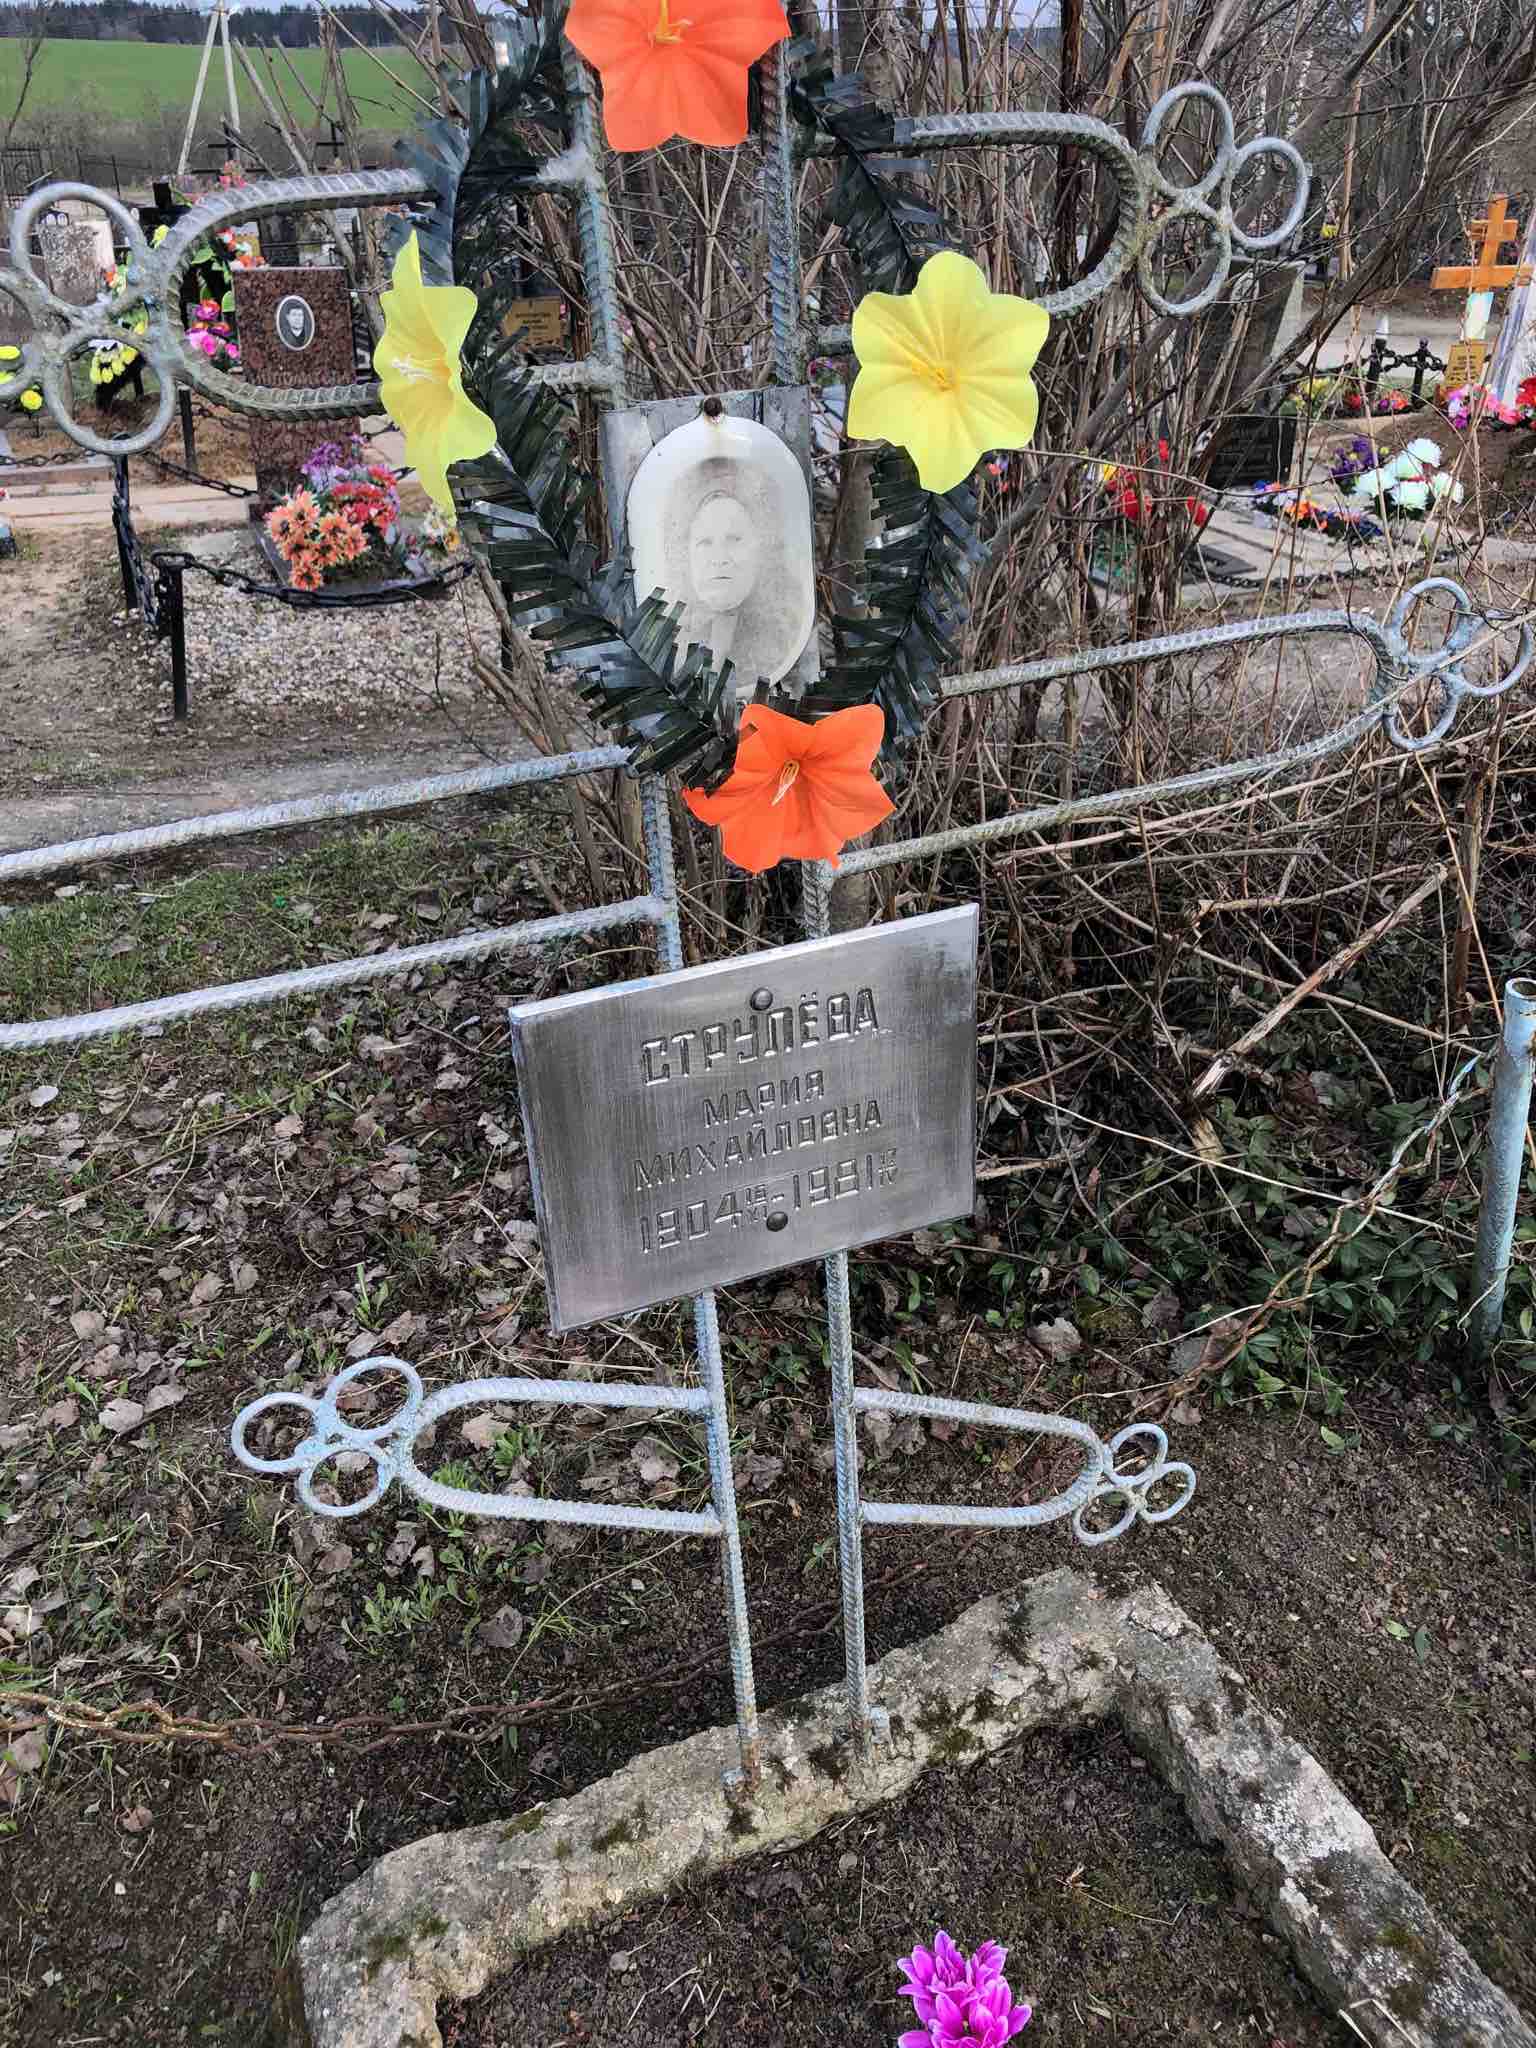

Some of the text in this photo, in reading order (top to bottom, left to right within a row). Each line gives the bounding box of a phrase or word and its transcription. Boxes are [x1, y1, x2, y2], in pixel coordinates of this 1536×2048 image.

[641, 988, 879, 1086] СТРУЛЁВА
[703, 1070, 825, 1128] МАРИЯ
[632, 1100, 881, 1192] МИХАЙЛОВНА
